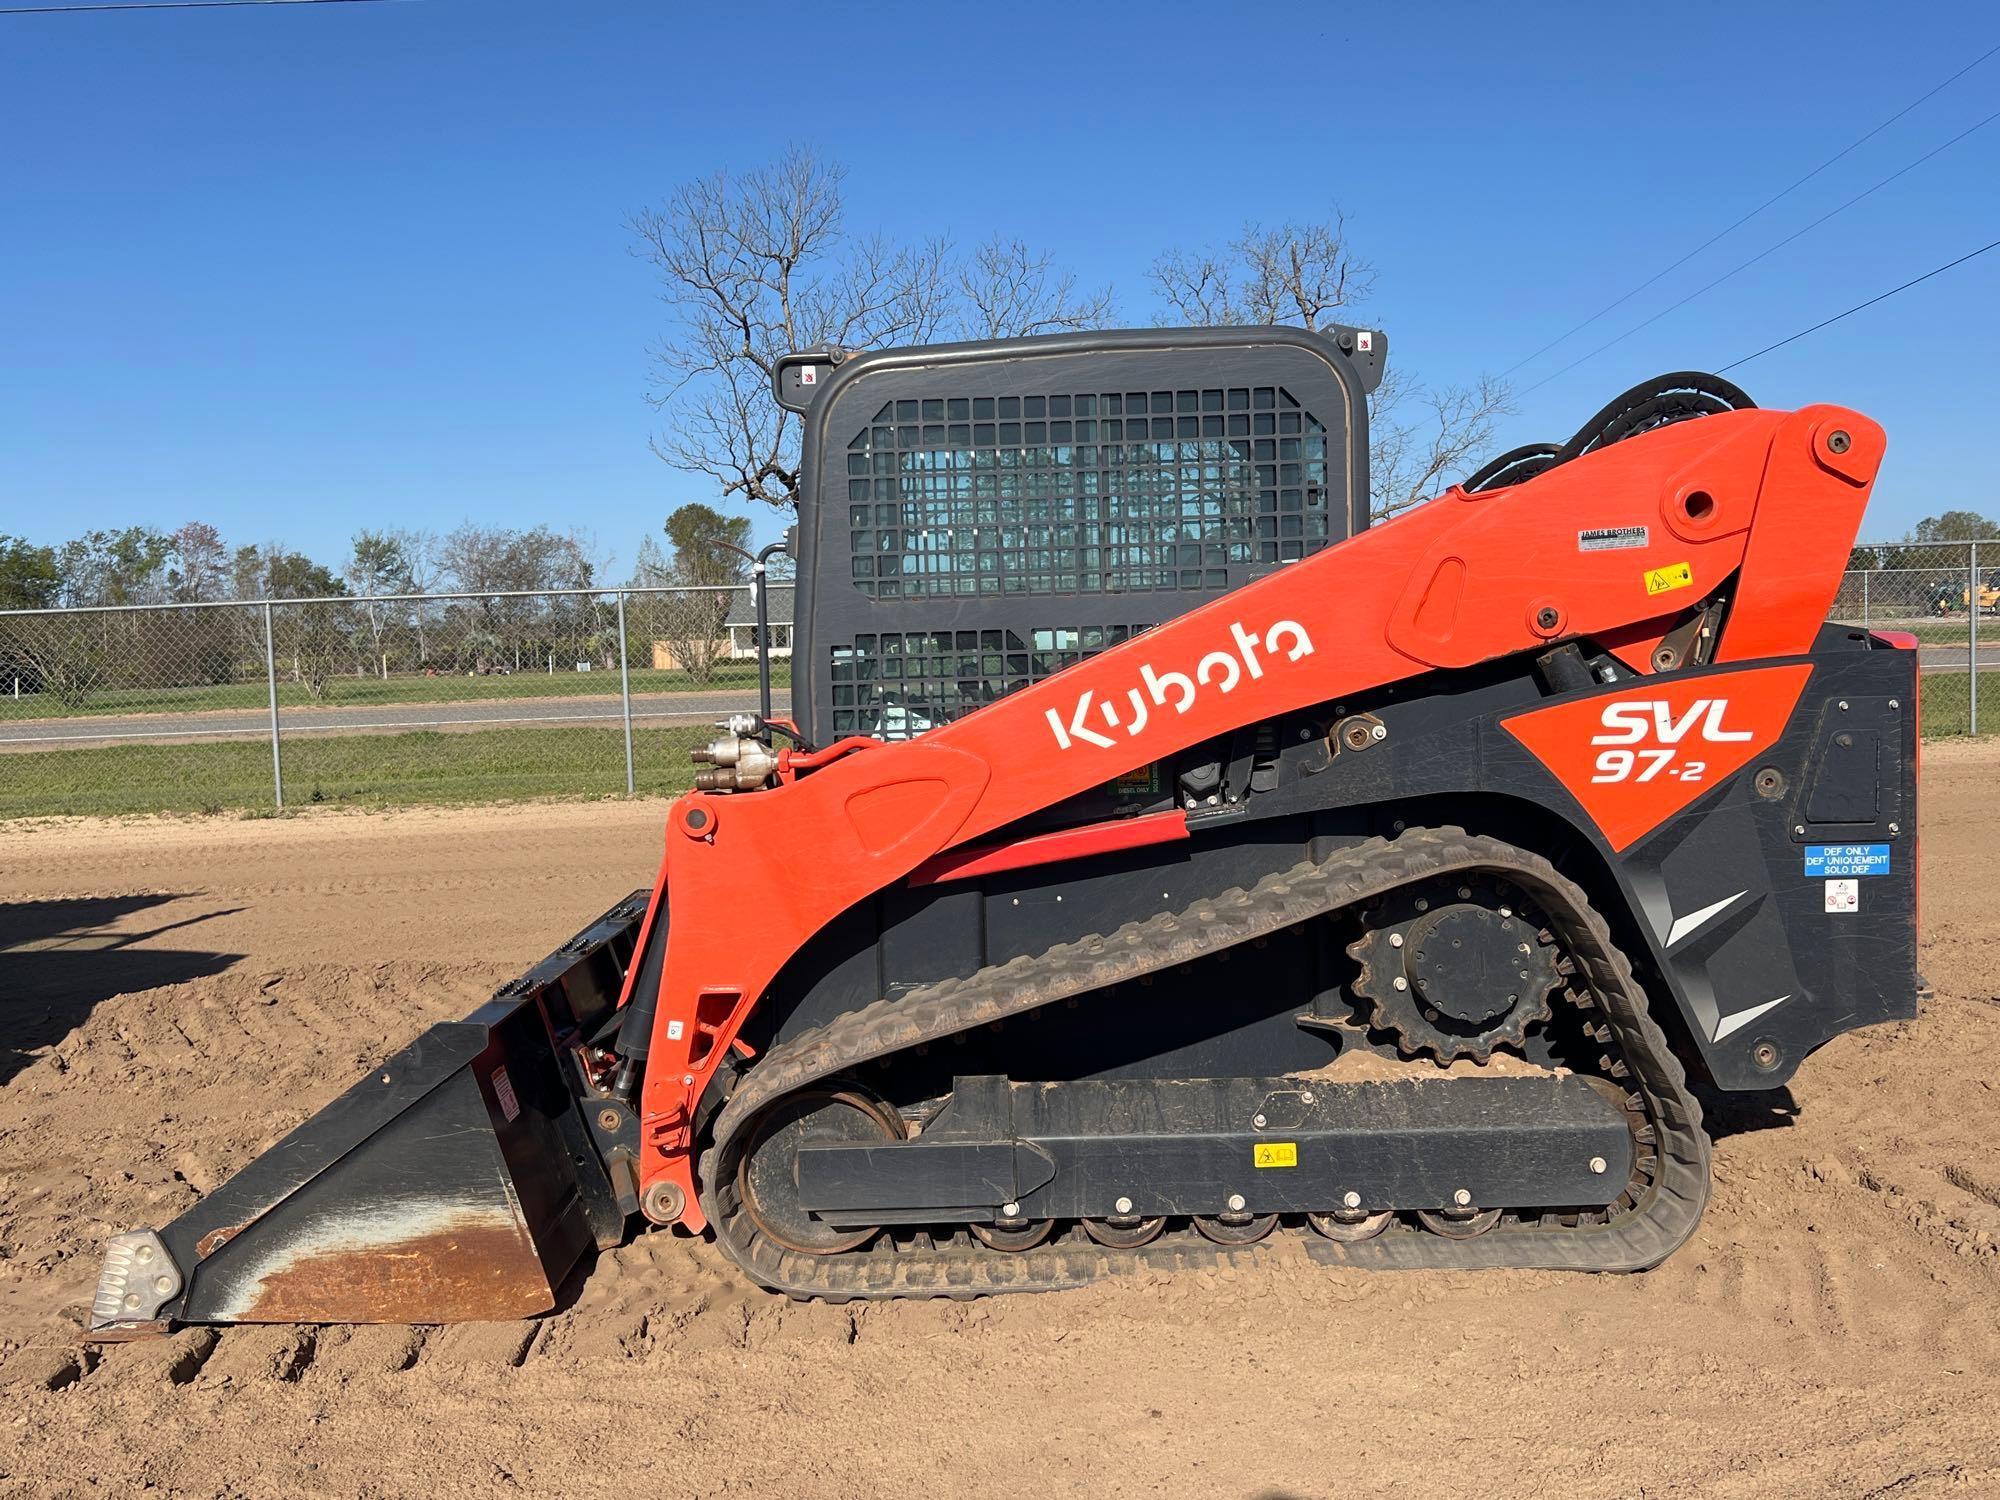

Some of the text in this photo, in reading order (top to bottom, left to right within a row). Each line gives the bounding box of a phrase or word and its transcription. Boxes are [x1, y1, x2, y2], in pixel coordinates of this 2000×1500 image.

[1582, 527, 1645, 538] JAMES BROTHERS
[1045, 620, 1315, 749] Kubota
[1591, 699, 1753, 745] SVL
[1591, 749, 1706, 783] 97-2
[1824, 847, 1870, 856] DEF ONLY
[1806, 855, 1888, 866] DEF UNIQUEMENT
[1824, 865, 1870, 874] SOLO DEF
